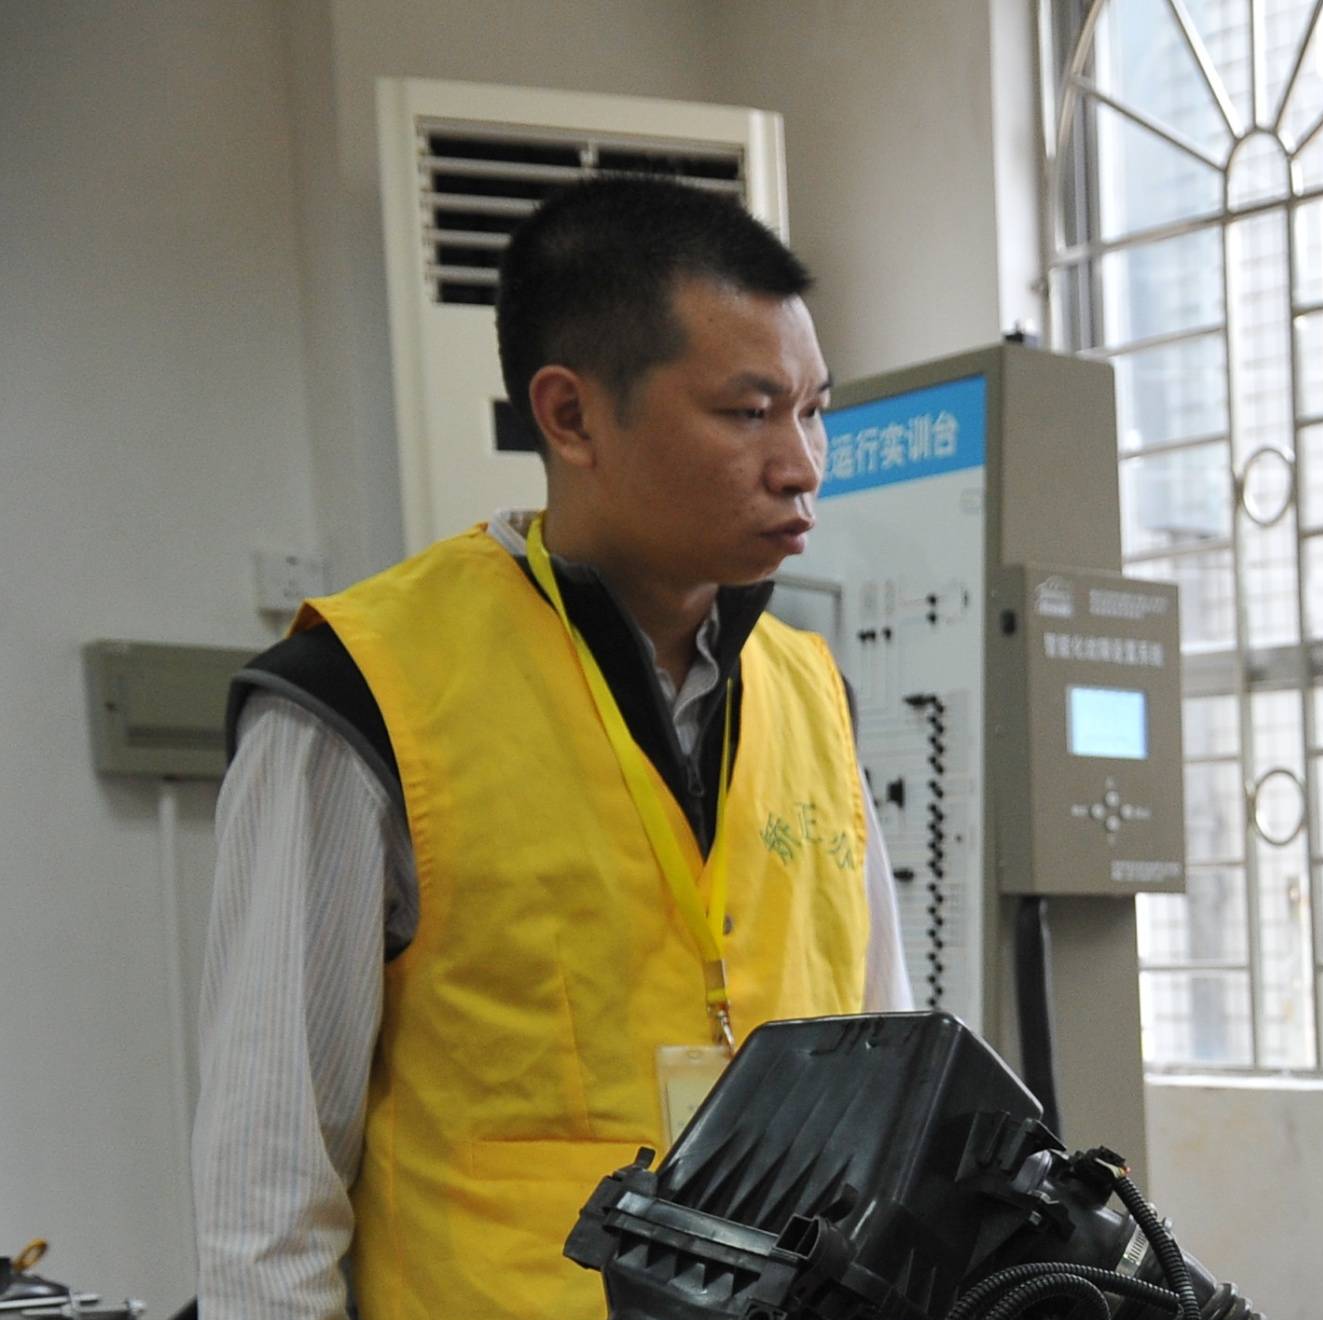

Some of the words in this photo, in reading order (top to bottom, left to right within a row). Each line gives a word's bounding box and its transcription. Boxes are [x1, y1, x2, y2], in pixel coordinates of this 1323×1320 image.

[827, 410, 960, 481] 运行实训台
